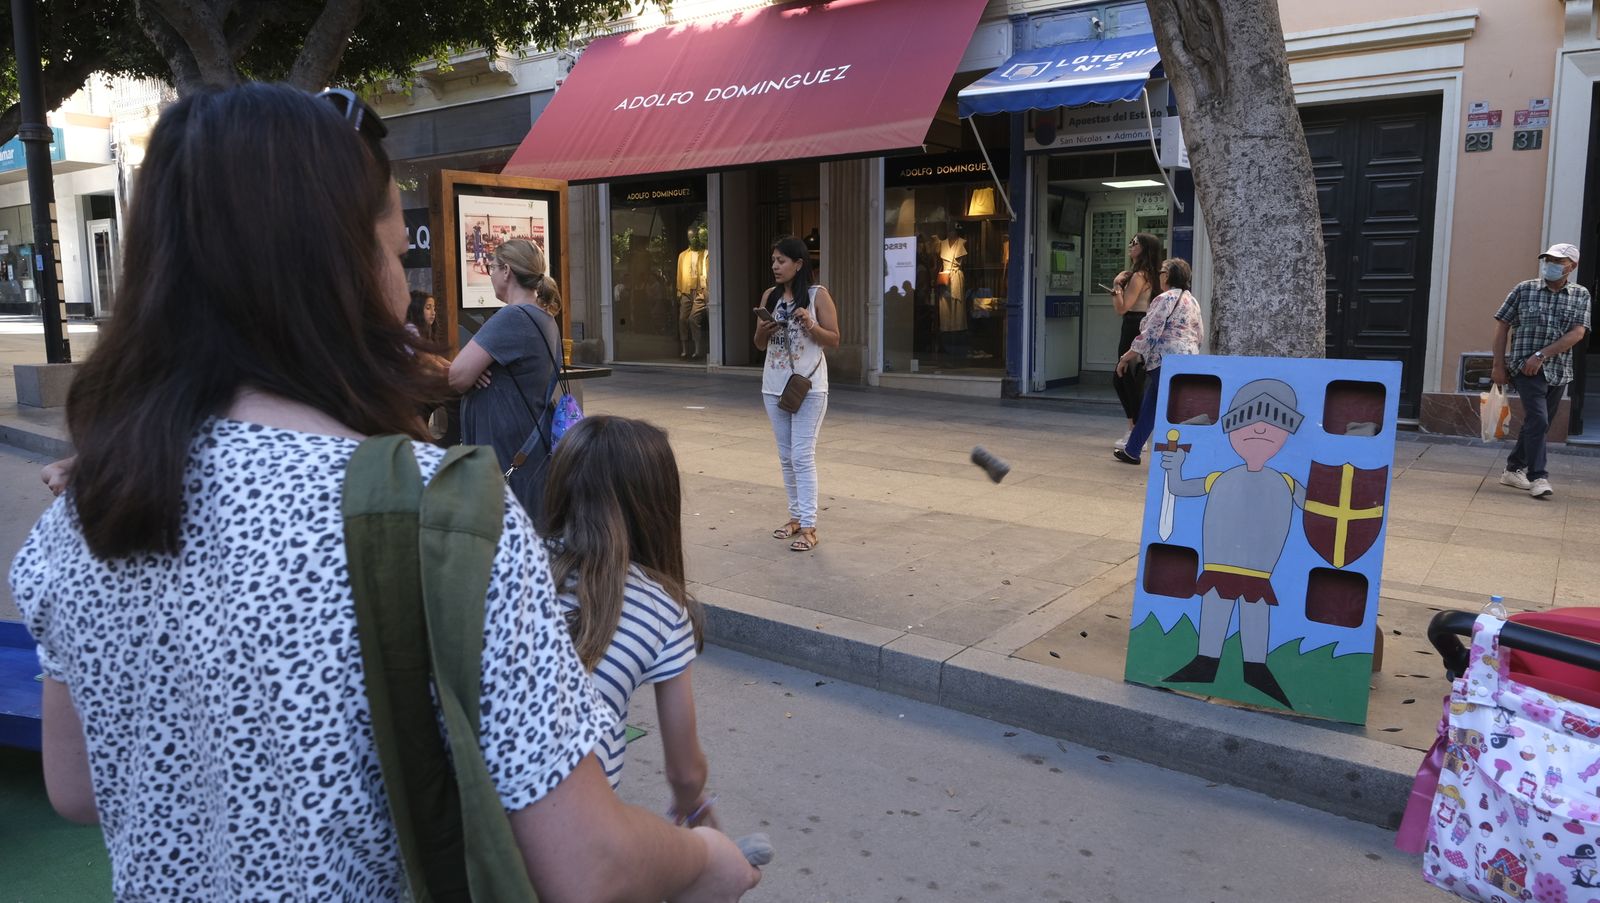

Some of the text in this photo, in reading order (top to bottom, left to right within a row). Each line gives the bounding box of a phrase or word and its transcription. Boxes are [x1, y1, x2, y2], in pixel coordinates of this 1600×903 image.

[1056, 46, 1158, 68] LOTERIA
[1104, 61, 1124, 71] 2
[614, 64, 851, 111] ADOLFO DOMINGUEZ
[1068, 109, 1162, 127] Apuestas del Estdo
[1060, 137, 1074, 145] San
[1466, 133, 1491, 151] 29
[1516, 131, 1538, 149] 31
[900, 167, 933, 177] ADOLFO
[626, 188, 690, 200] ADOLFO DOMINGUEZ
